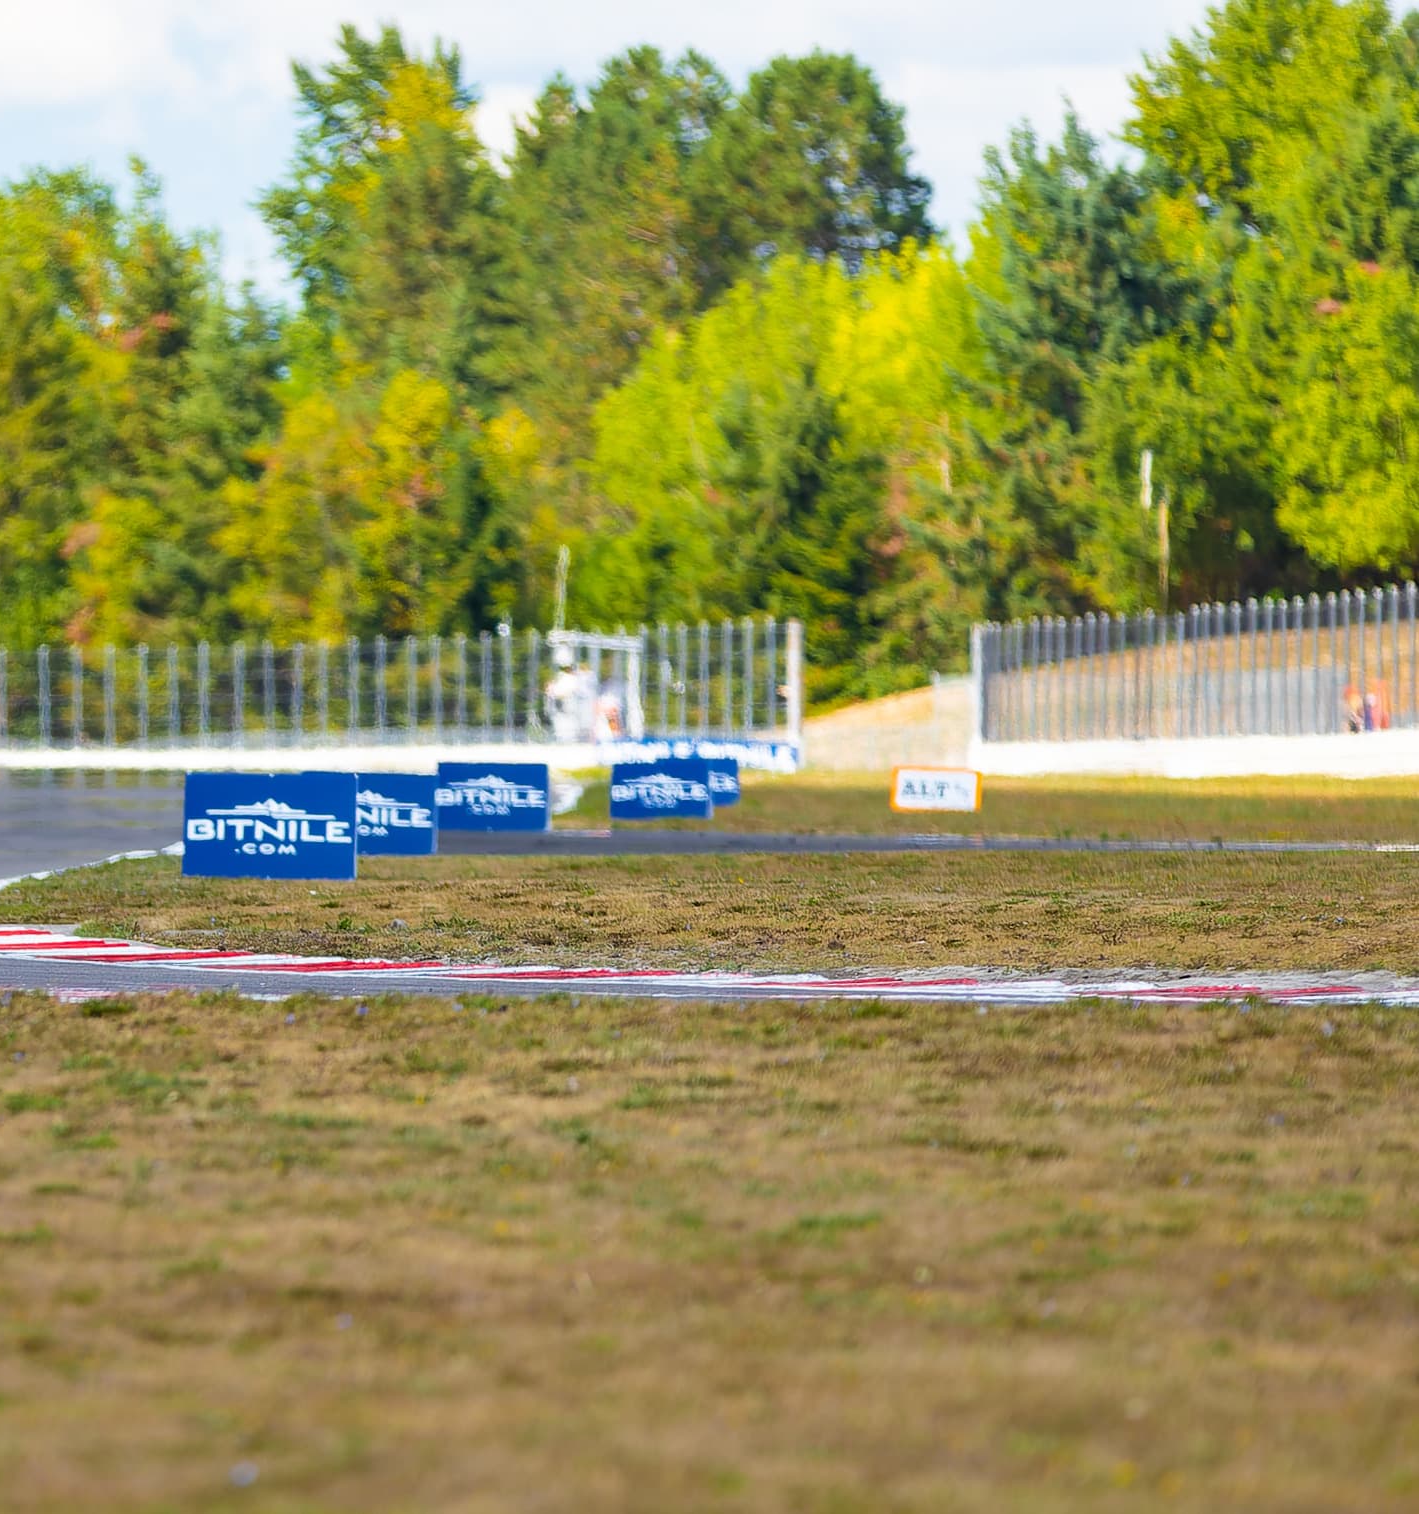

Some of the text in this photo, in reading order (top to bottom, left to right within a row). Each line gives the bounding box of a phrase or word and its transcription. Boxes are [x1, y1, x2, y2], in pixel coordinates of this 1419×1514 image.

[434, 788, 547, 808] BITNILE
[356, 806, 433, 828] NILE
[186, 818, 353, 844] BITNILE
[356, 825, 389, 837] OM
[234, 842, 297, 856] .COM
